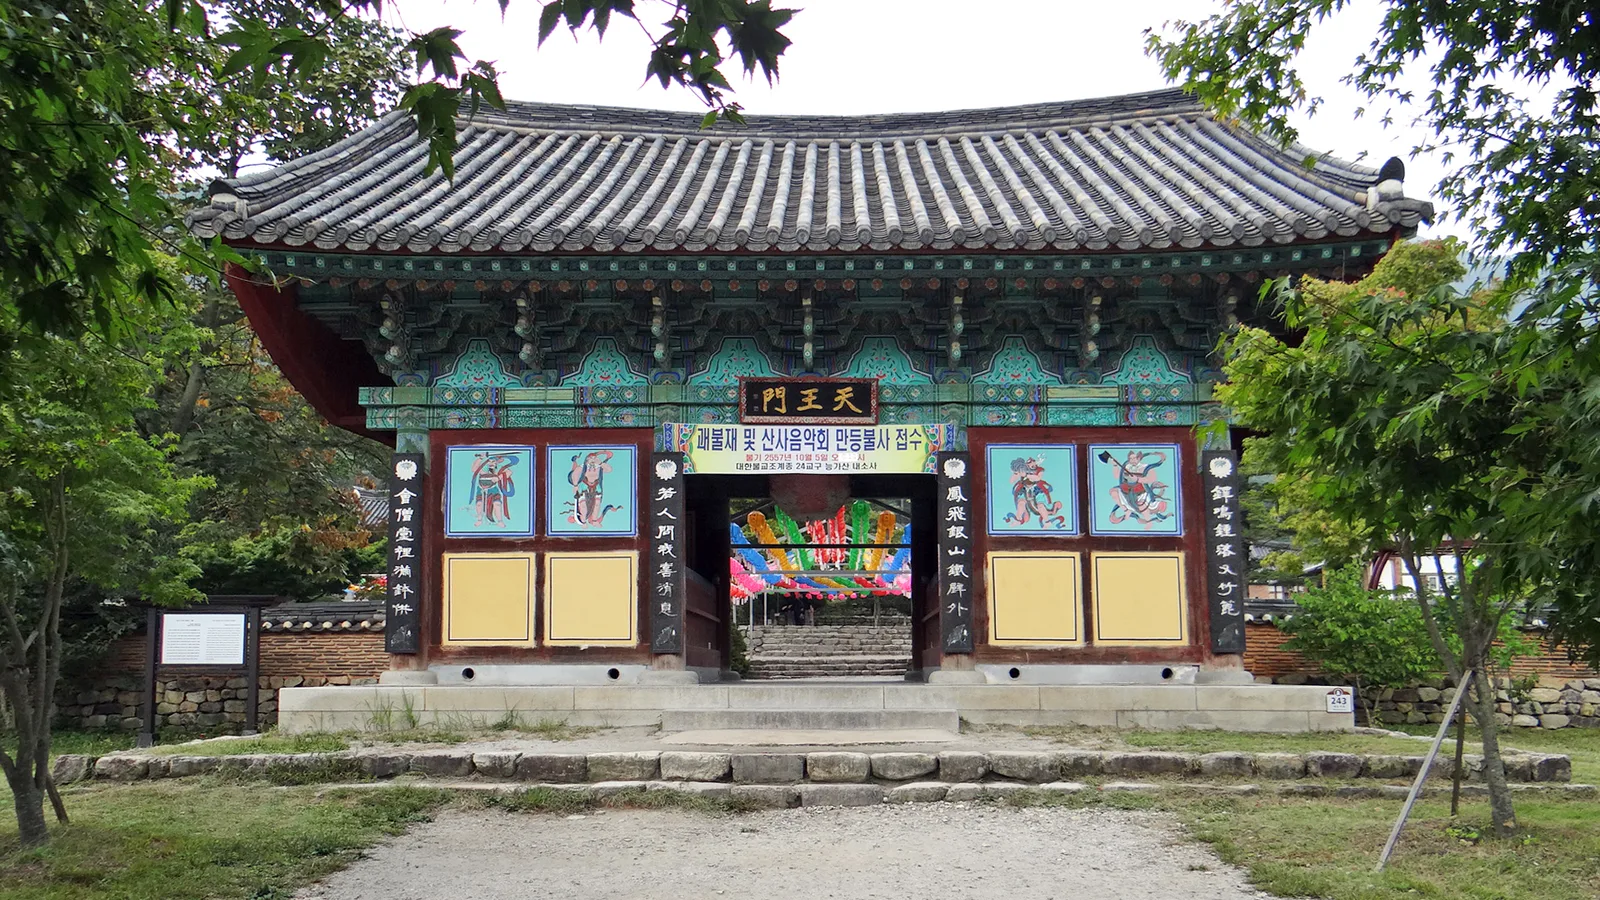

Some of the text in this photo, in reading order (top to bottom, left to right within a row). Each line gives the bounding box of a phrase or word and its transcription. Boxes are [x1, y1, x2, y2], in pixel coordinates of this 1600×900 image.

[696, 428, 922, 452] 괘불재 및 산사음악회 만등불사 접수
[745, 453, 762, 462] 불기
[764, 453, 792, 462] 2557년
[795, 453, 812, 461] 10월
[815, 453, 829, 461] 5일
[736, 462, 877, 471] 대한불교조계종 24교구 능가산 내소사
